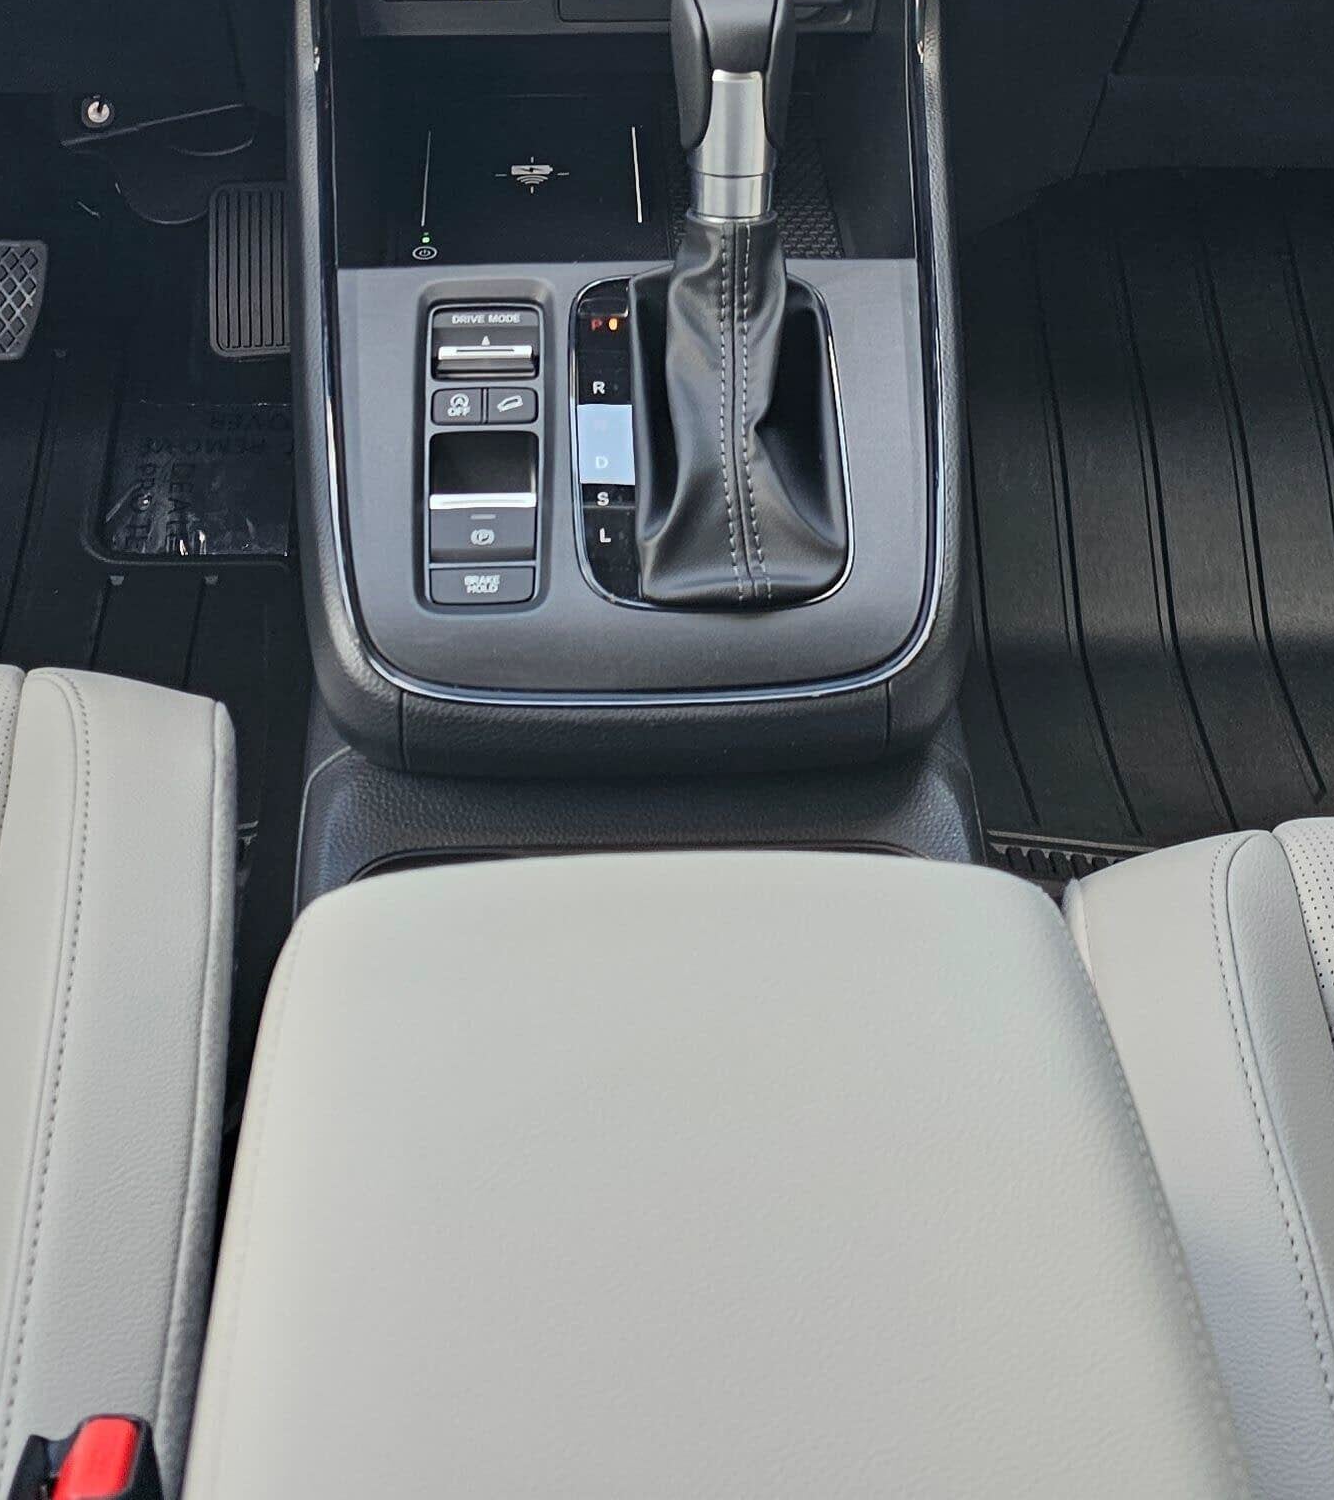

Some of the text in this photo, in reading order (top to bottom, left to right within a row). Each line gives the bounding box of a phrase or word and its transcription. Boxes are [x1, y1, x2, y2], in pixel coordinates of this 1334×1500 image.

[451, 313, 521, 325] DRIVE MODE
[592, 380, 606, 395] R
[595, 455, 609, 469] D
[597, 491, 610, 506] S
[599, 527, 612, 543] L
